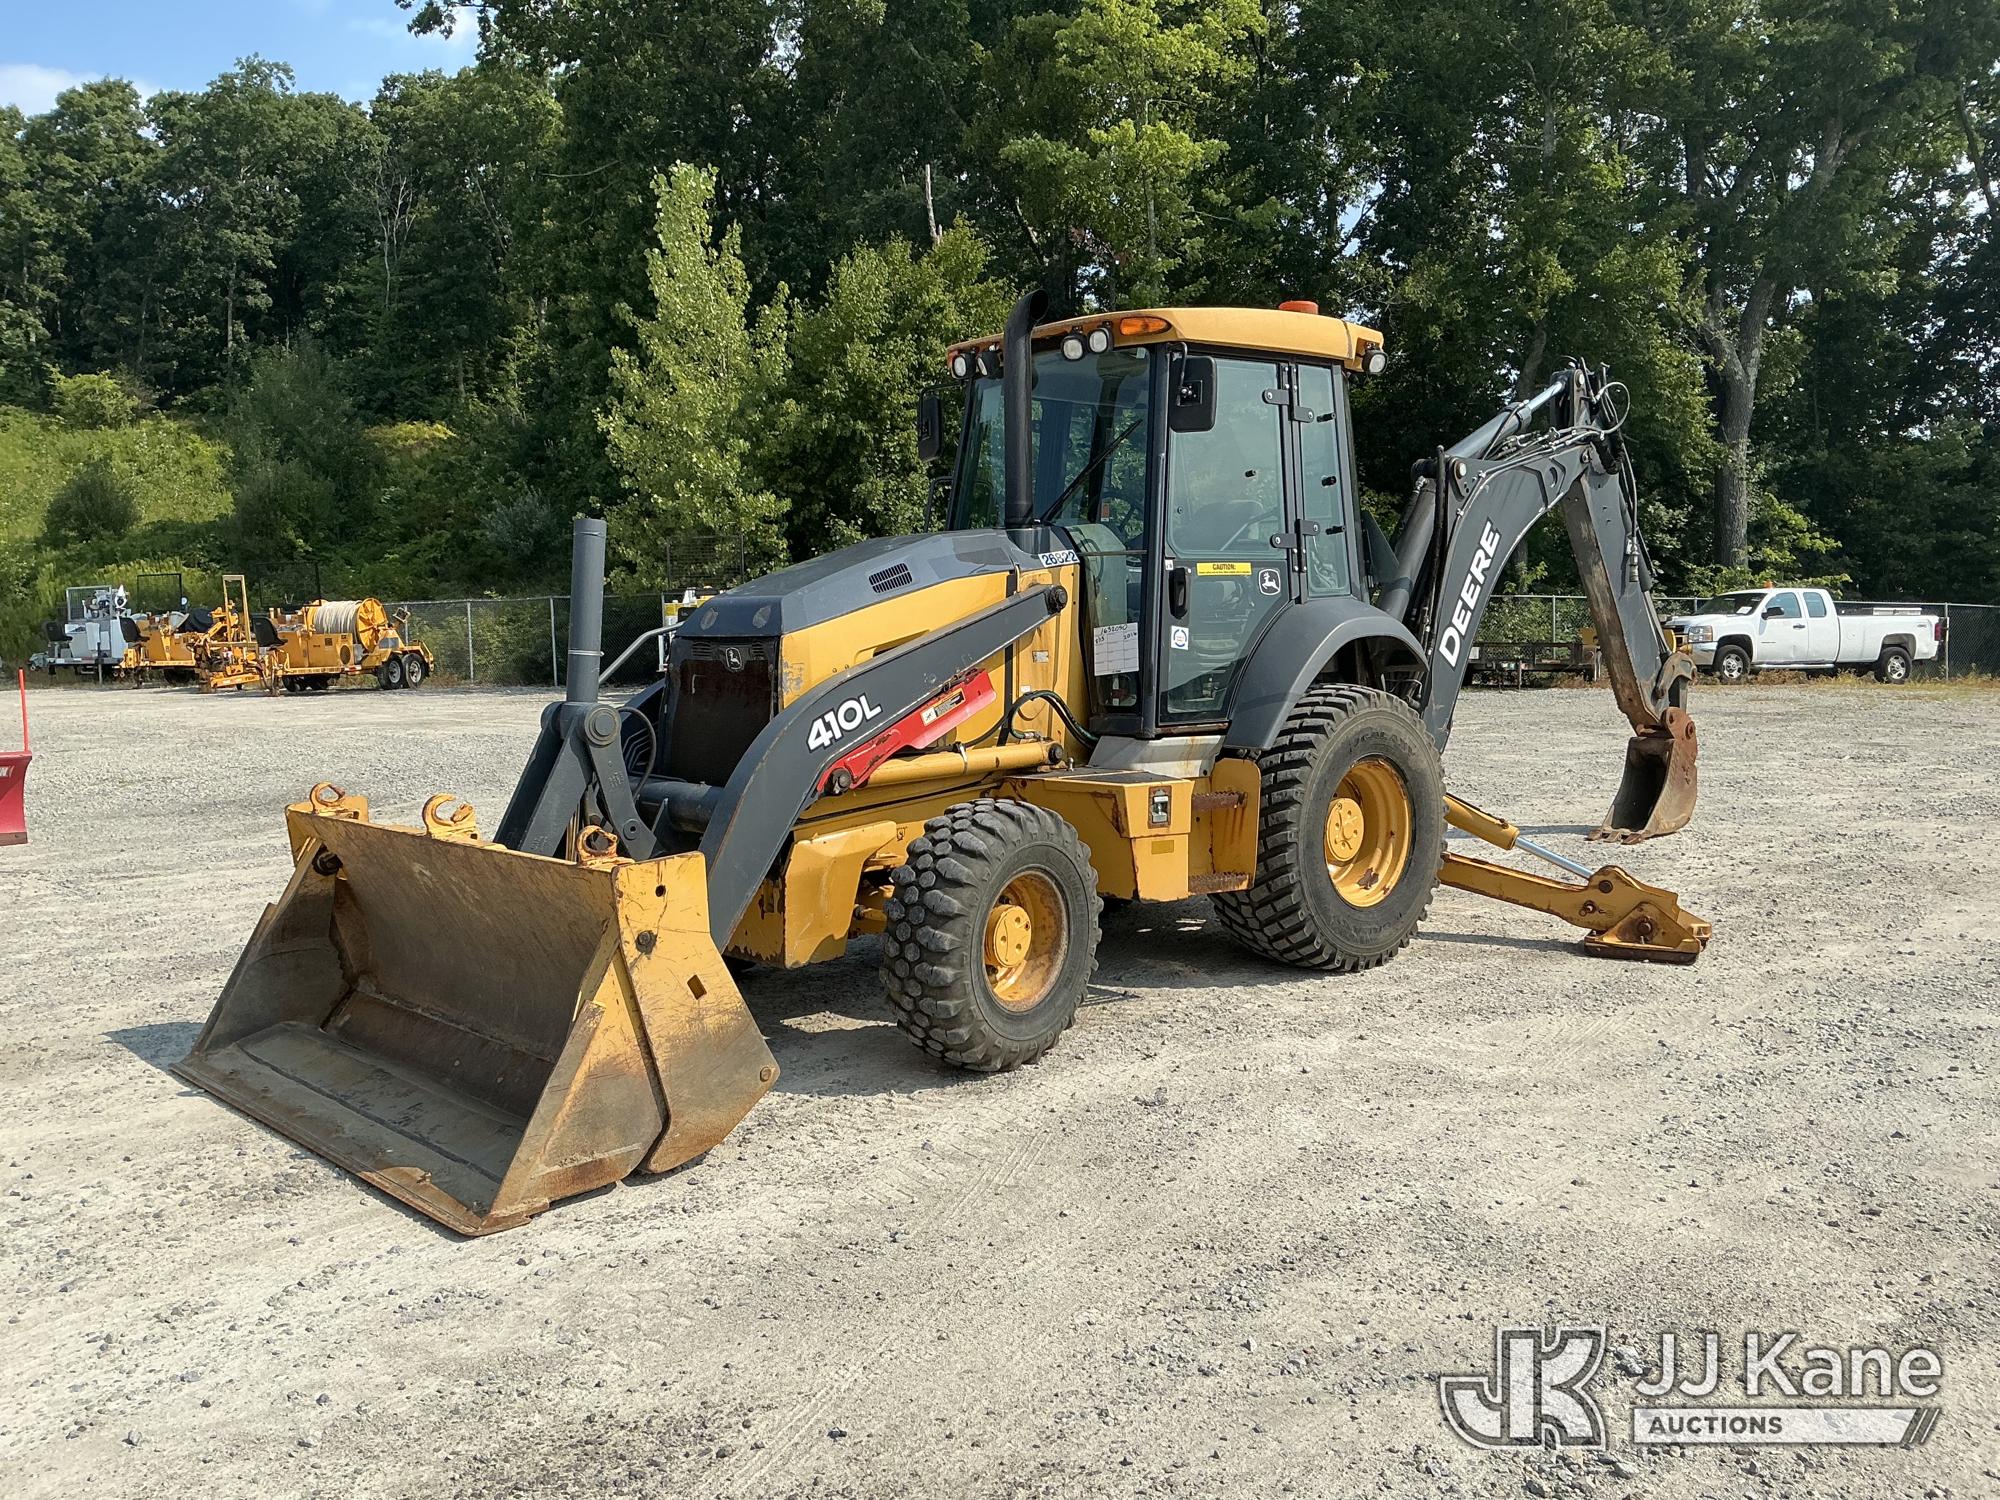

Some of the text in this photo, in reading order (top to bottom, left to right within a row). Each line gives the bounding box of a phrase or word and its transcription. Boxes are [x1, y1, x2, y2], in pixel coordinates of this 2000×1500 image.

[1041, 550, 1078, 566] 26822
[1439, 520, 1500, 668] DEERE
[807, 694, 882, 751] 410L
